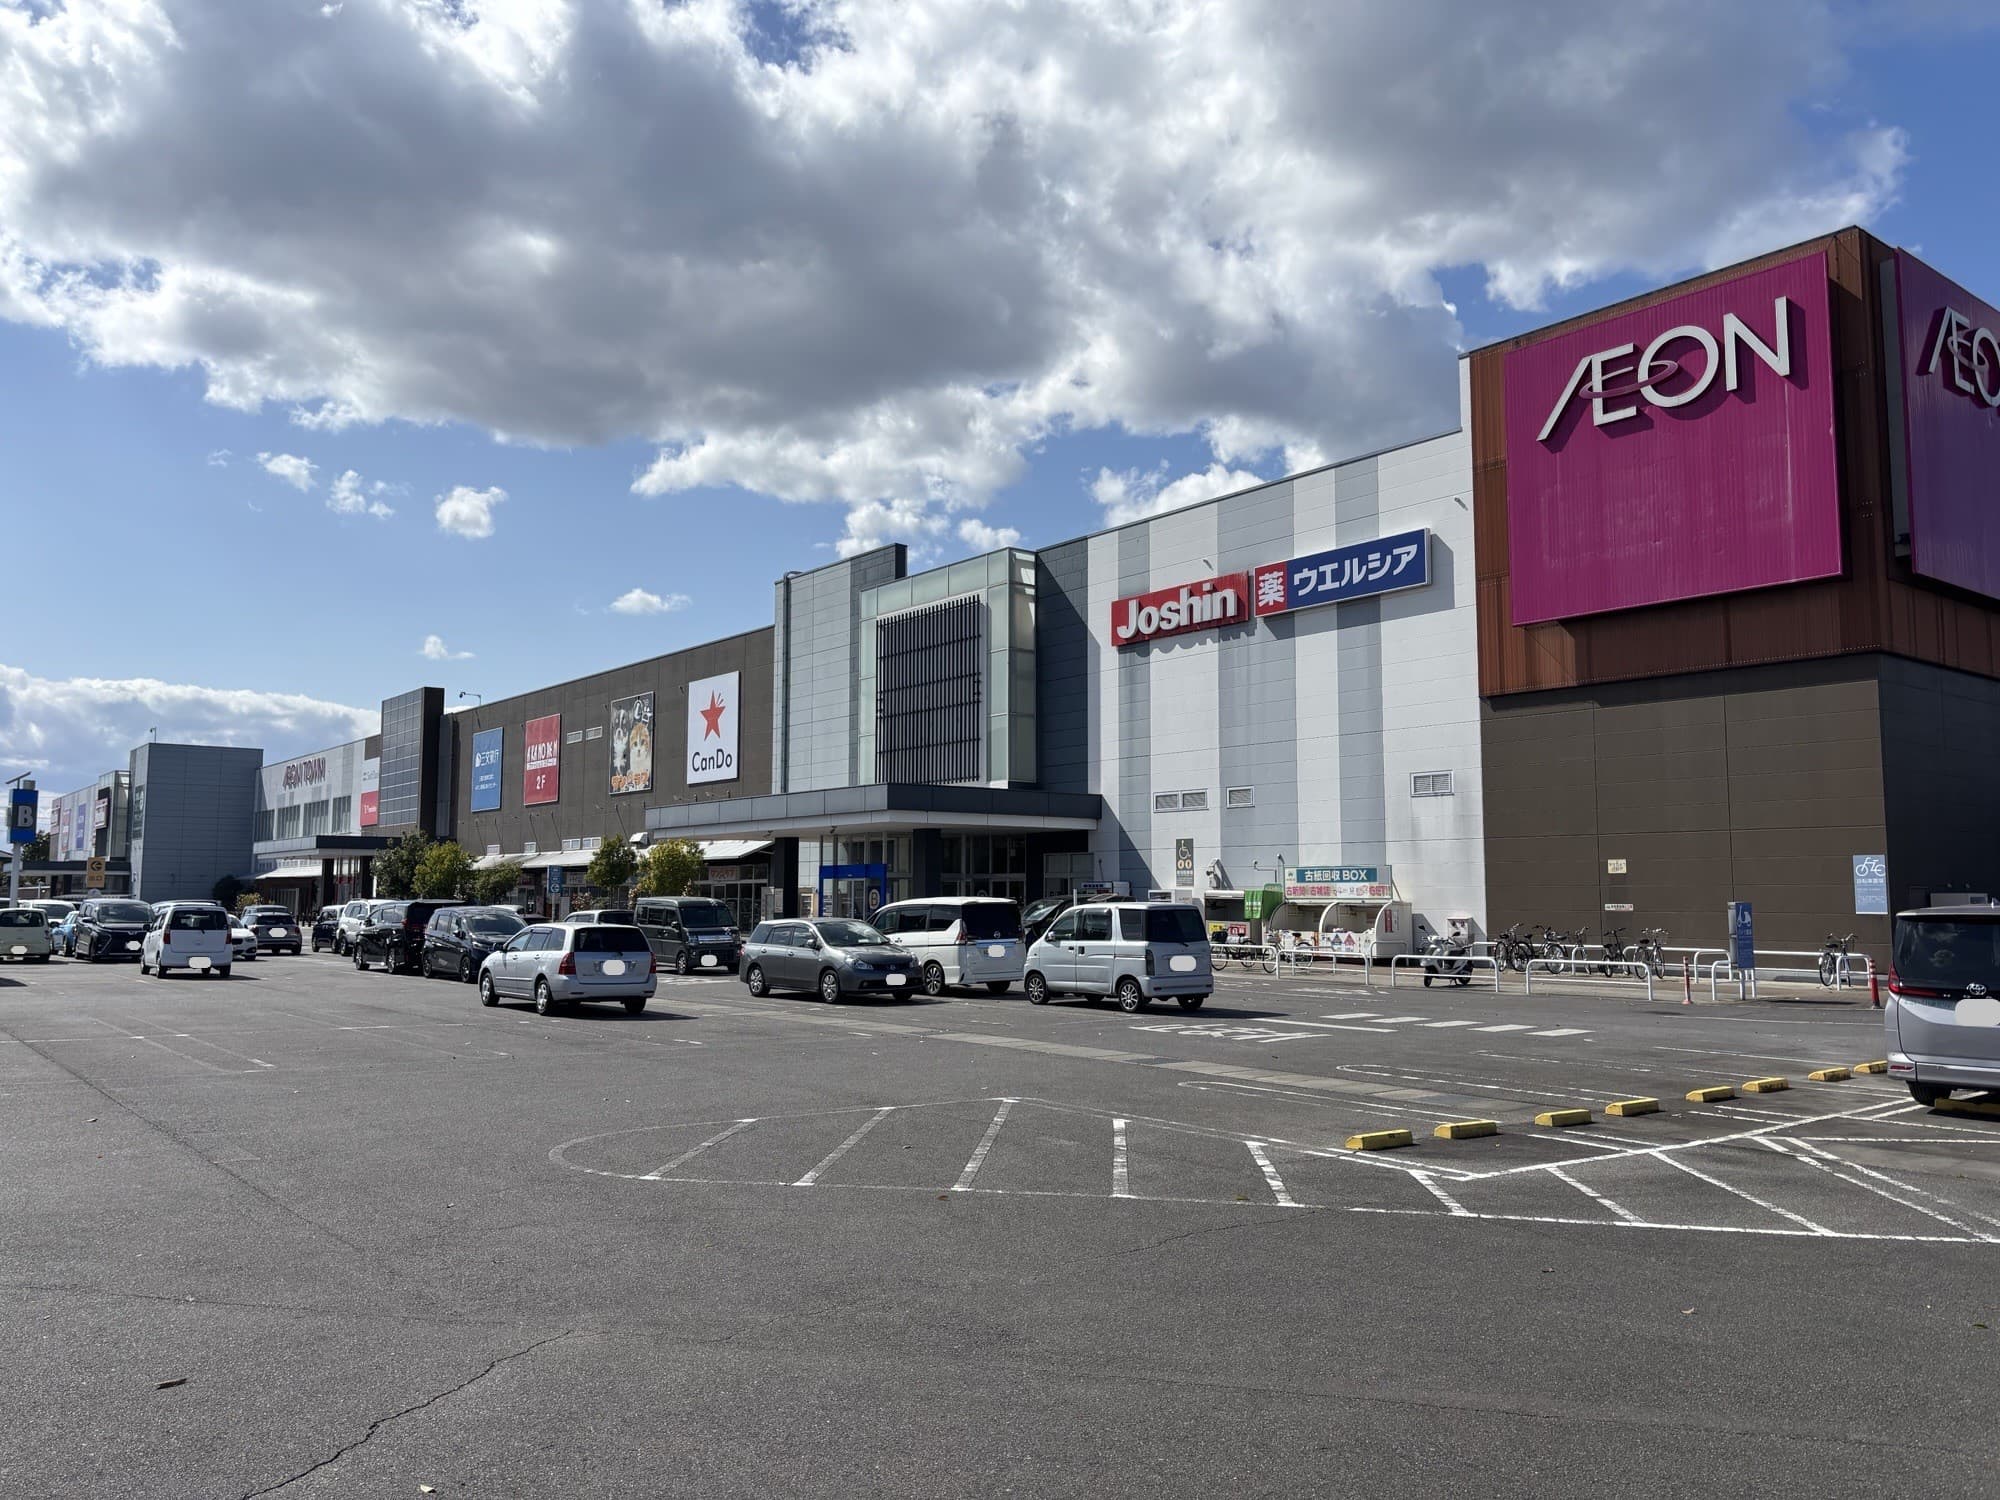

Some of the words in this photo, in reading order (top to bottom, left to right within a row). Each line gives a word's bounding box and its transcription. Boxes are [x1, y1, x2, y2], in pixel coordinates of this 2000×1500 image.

[1258, 571, 1285, 606] 薬
[1293, 544, 1418, 597] ウエルシア
[1117, 584, 1237, 639] Joshin
[692, 748, 733, 773] CanDo
[536, 775, 546, 790] 2F
[17, 805, 34, 827] B
